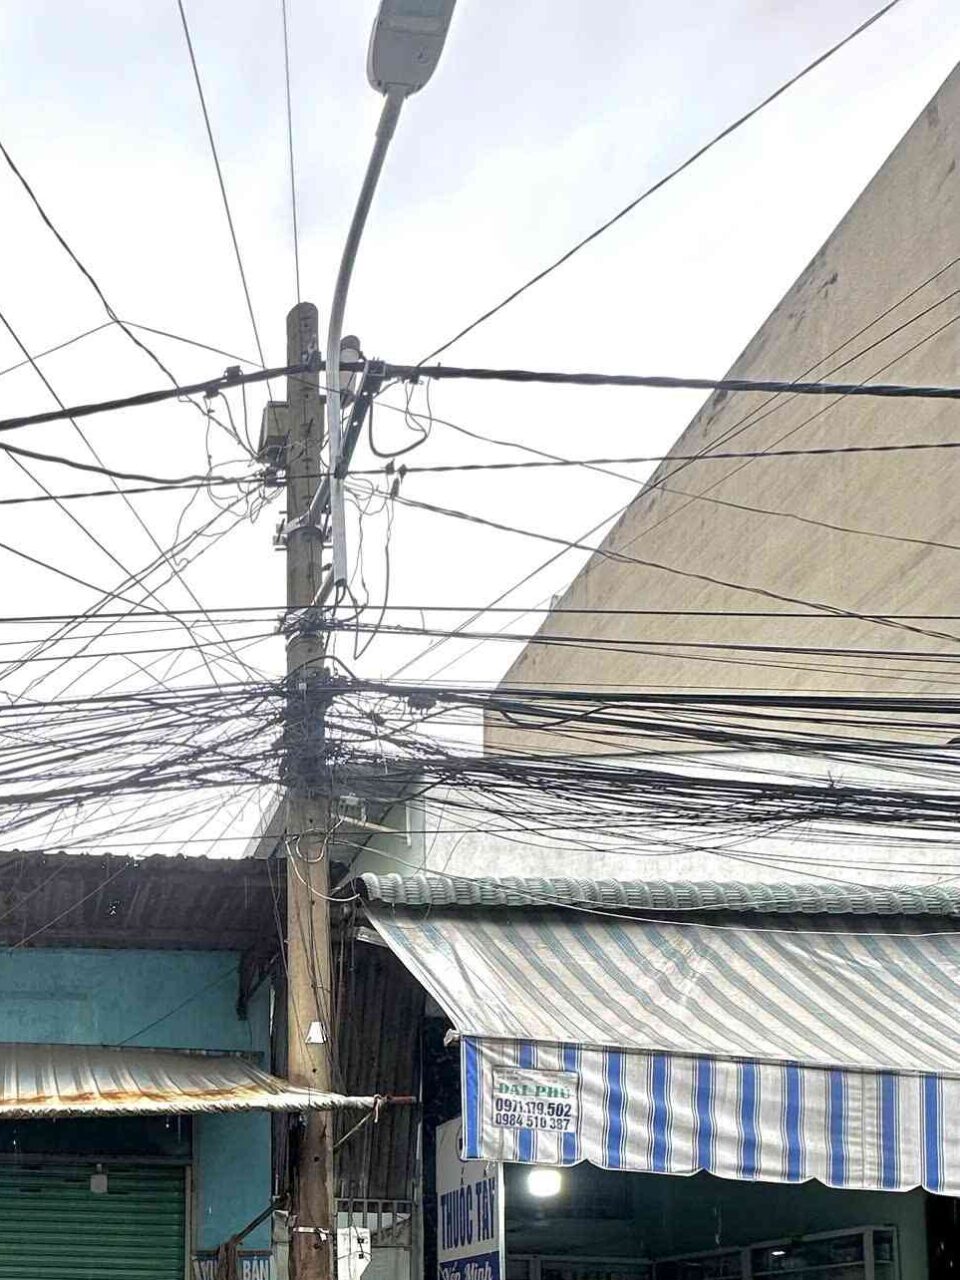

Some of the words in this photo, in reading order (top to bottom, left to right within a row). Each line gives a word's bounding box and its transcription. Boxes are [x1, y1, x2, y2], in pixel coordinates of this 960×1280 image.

[495, 1098, 572, 1117] 0971.179.502
[495, 1113, 523, 1127] 0984
[440, 1168, 473, 1250] THUỐC
[475, 1169, 497, 1242] TÂY
